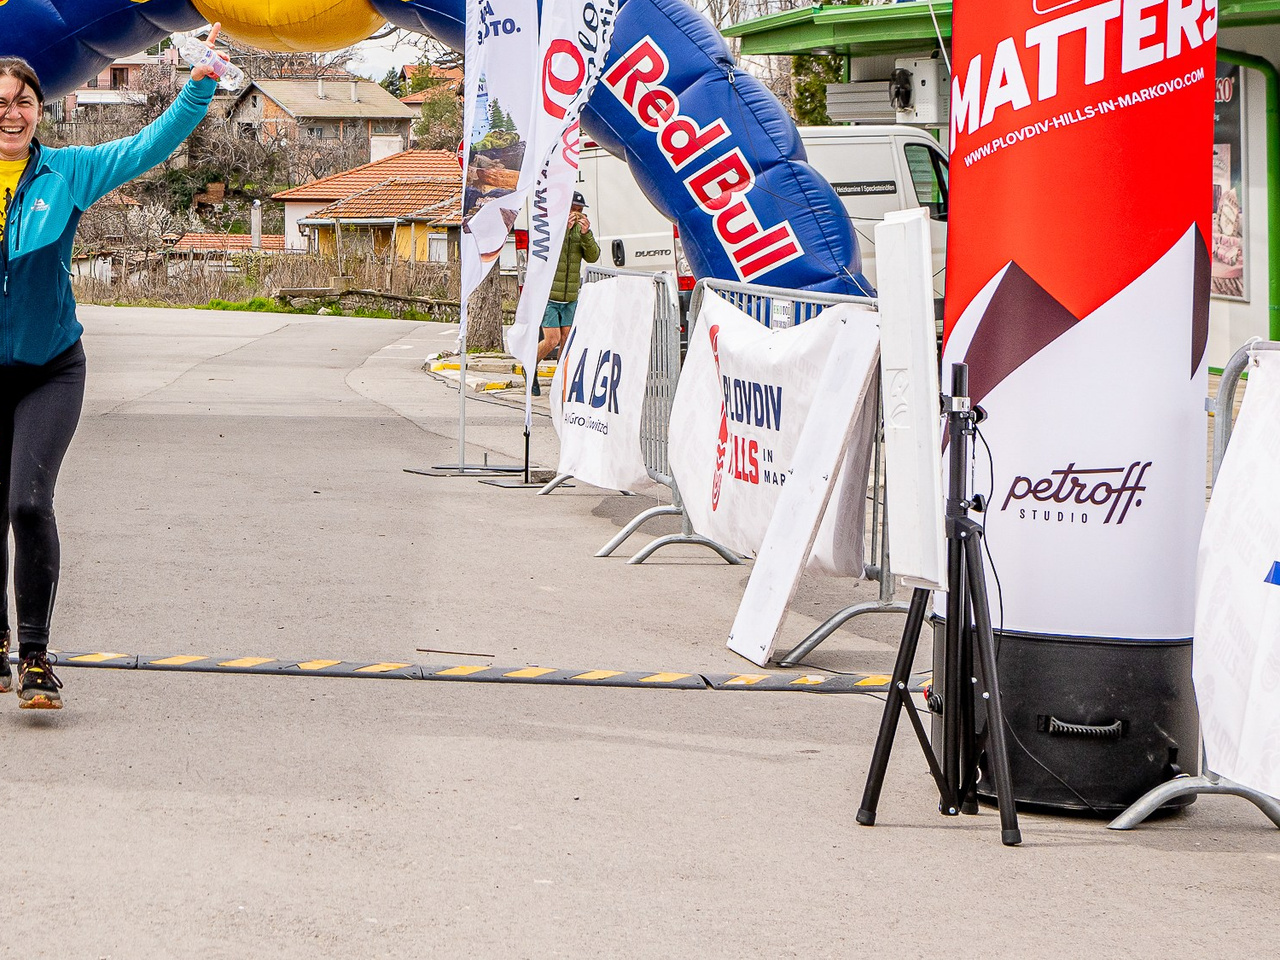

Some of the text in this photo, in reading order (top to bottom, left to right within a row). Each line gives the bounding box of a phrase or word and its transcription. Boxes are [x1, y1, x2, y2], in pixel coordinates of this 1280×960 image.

[606, 40, 726, 167] Red
[964, 67, 1205, 168] WWW.PLOVDIV-HILLS-IN-MARKOVO.COM
[689, 151, 798, 279] Bull
[635, 249, 671, 257] DUCATO
[723, 375, 782, 431] PLOVDIV
[763, 448, 773, 463] IN
[1019, 509, 1088, 523] STUDIO
